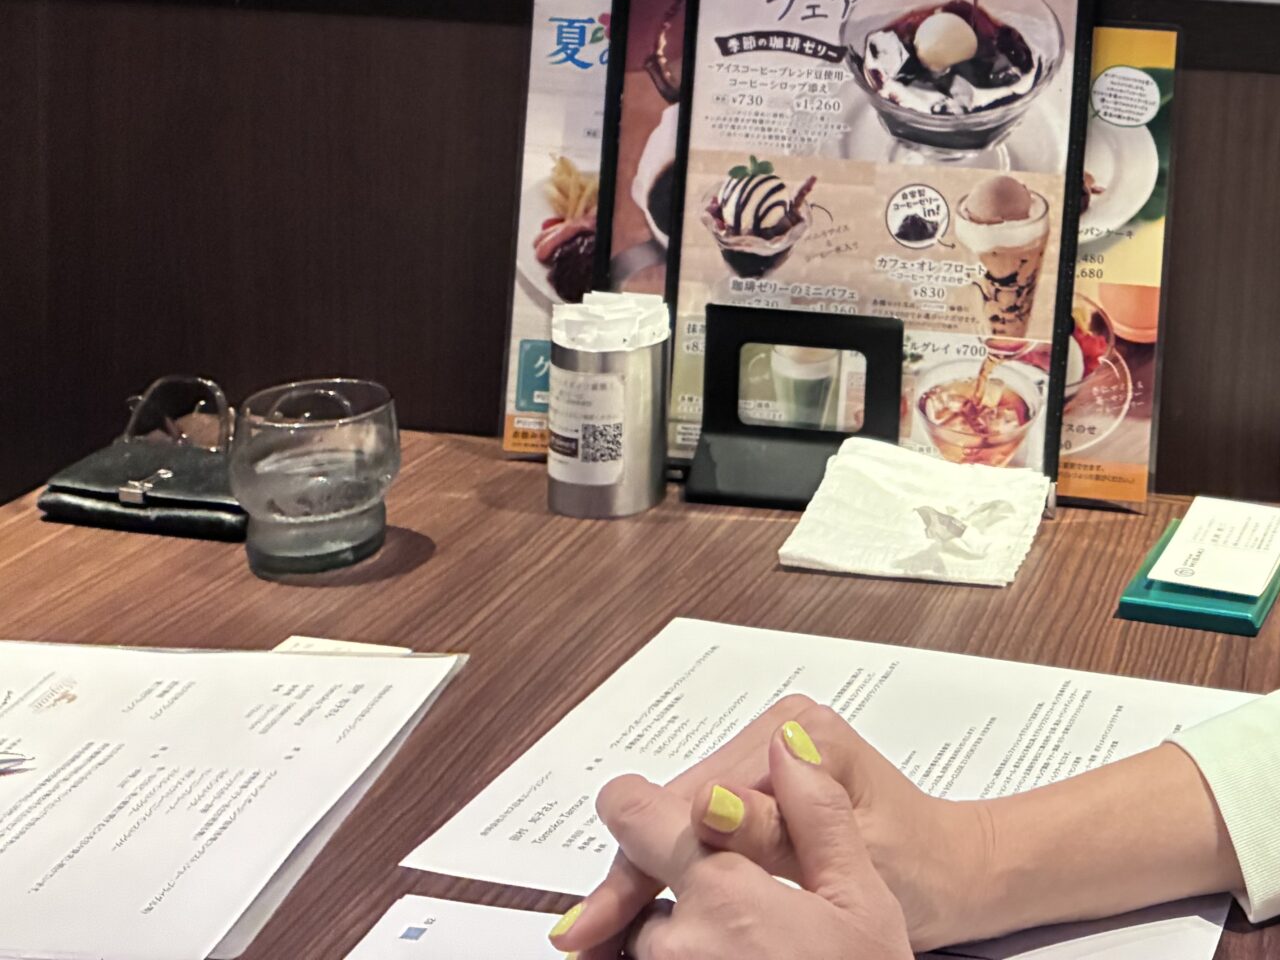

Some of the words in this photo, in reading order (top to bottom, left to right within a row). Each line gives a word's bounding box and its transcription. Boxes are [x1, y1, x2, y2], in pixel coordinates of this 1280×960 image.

[726, 35, 839, 58] 季節の珈琲ゼリー
